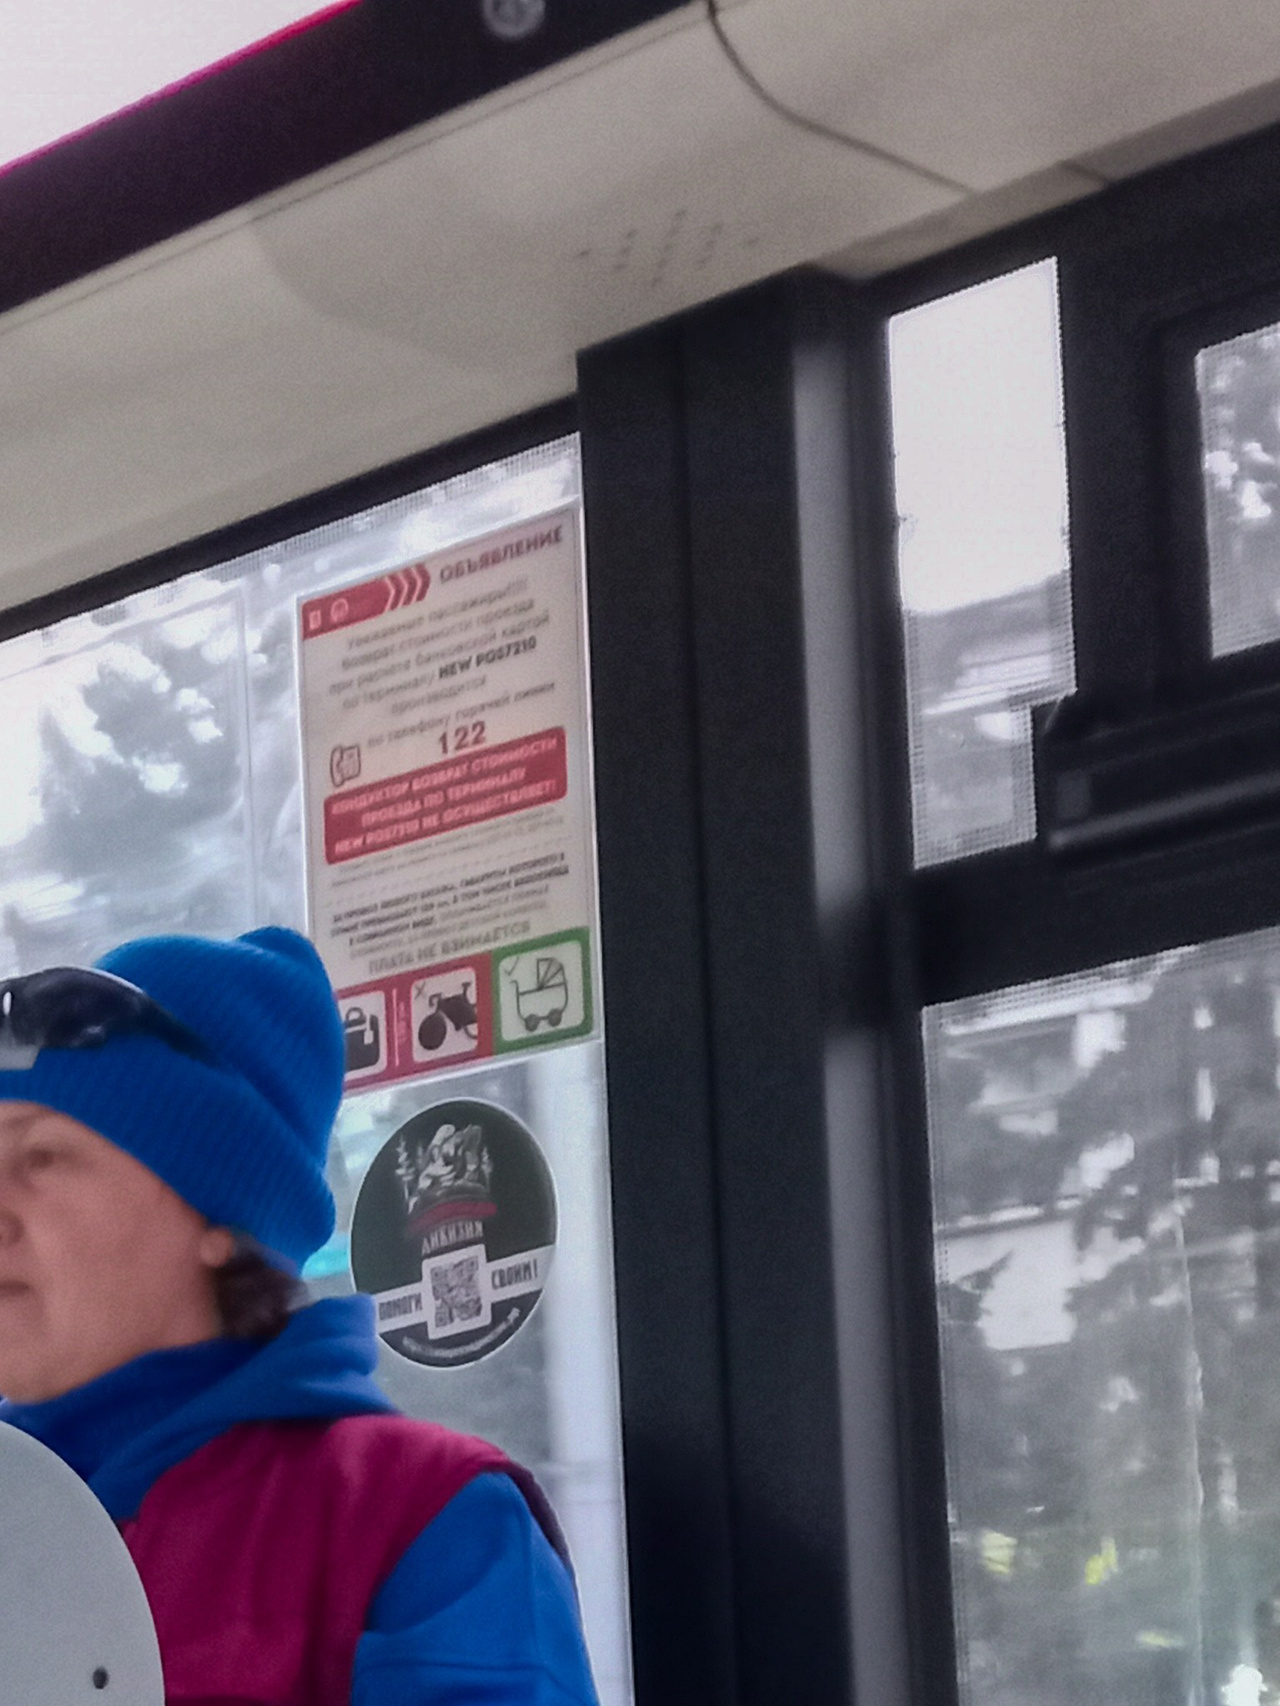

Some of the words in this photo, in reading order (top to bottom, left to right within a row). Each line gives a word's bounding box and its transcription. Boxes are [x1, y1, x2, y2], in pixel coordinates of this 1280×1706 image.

[439, 525, 564, 583] ОБЪЯВЛЕНИЕ
[438, 655, 473, 680] NEW
[438, 720, 487, 754] 122
